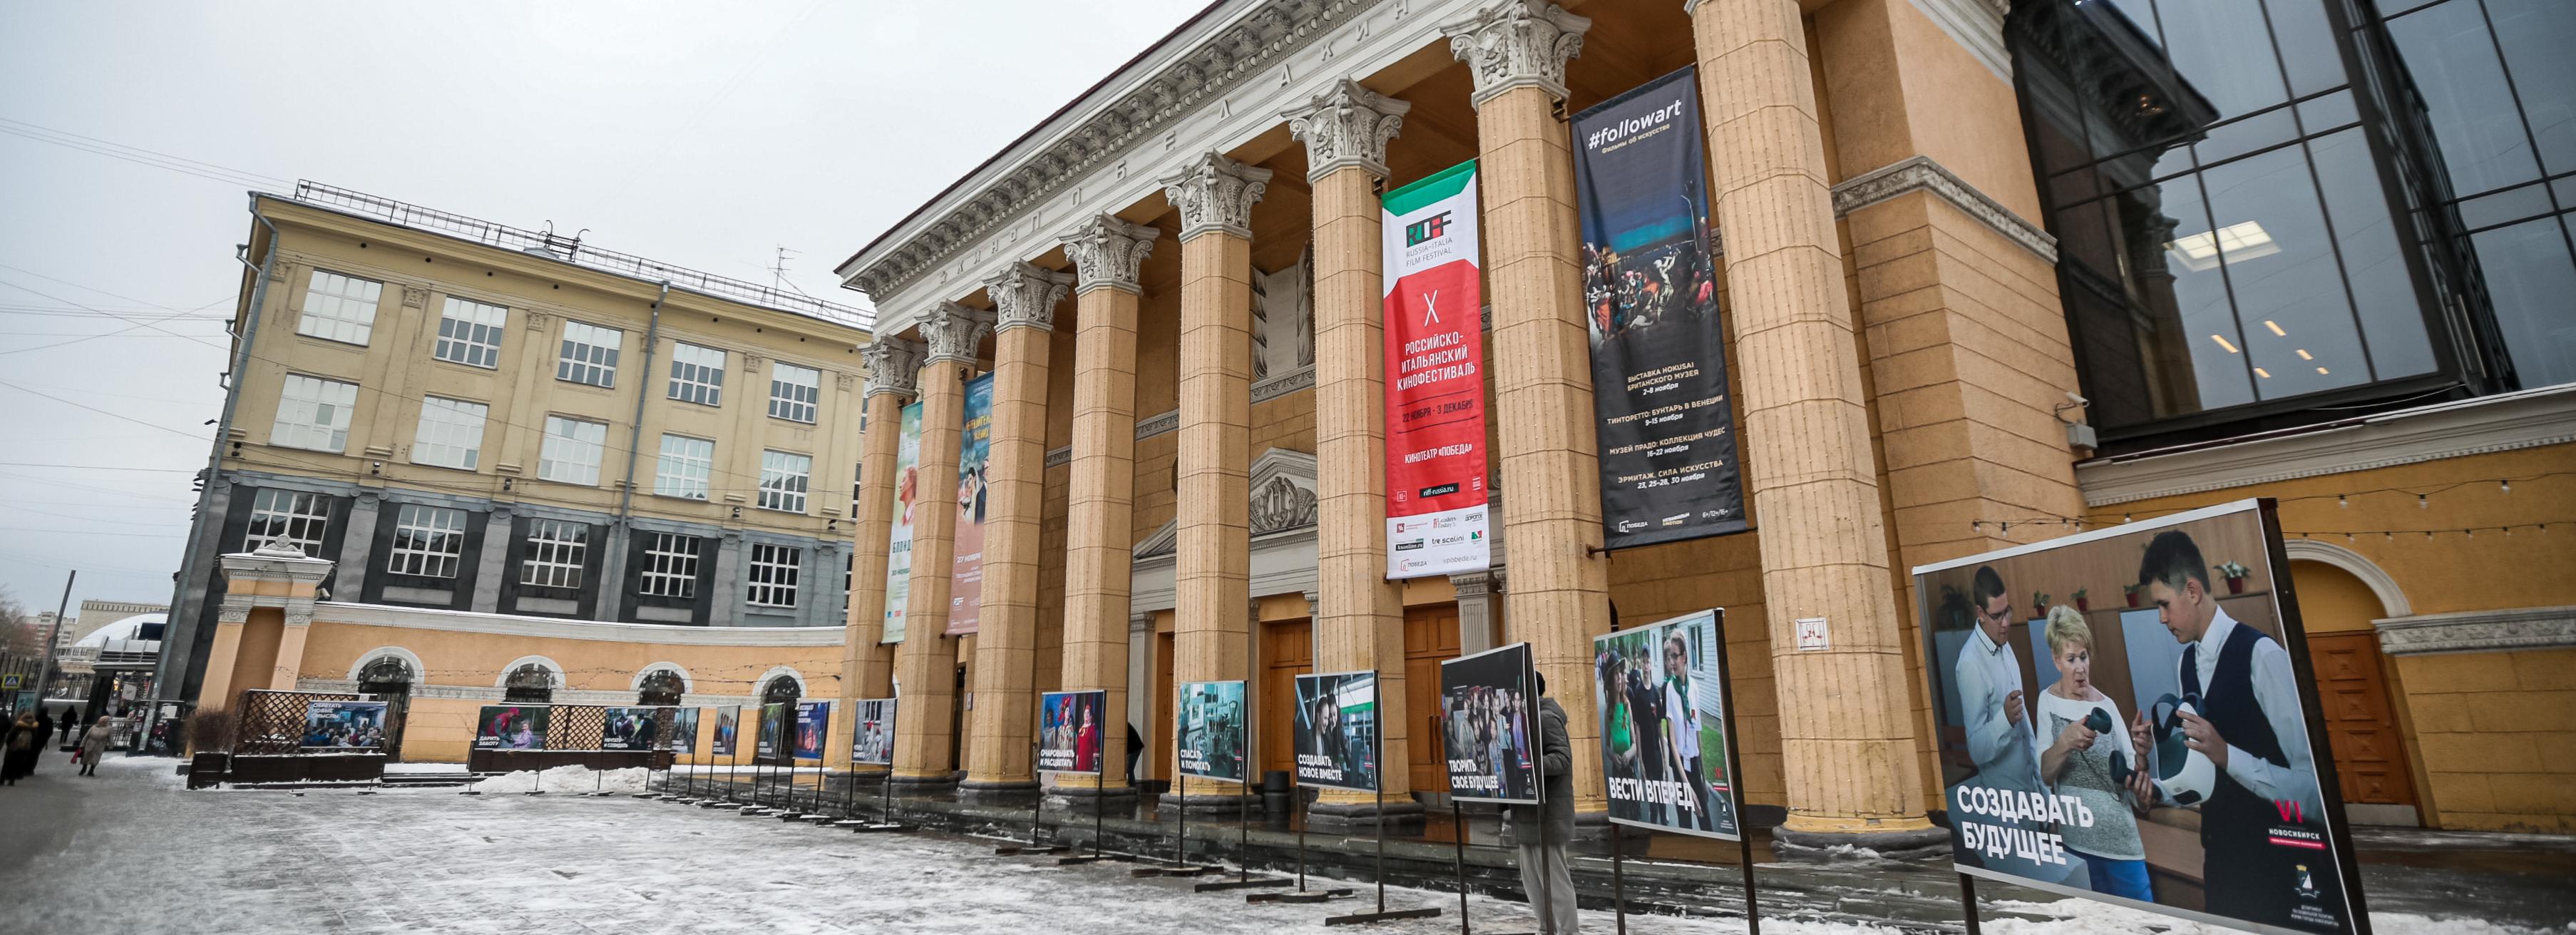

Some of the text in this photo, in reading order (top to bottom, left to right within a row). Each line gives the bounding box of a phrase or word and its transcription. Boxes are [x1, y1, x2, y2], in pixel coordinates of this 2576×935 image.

[1589, 99, 1682, 150] #followart
[1601, 140, 1627, 153] Фильмы
[1406, 237, 1453, 258] RUSSIA-ITALIA
[1406, 247, 1452, 267] FILM FESTIVAL
[1405, 332, 1464, 356] РОССИЙСКО-
[1401, 344, 1468, 374] ИТАЛЬЯНСКИЙ
[1397, 361, 1475, 392] КИНОФЕСТИВАЛЬ
[1627, 369, 1699, 391] БРИТАНСКОГО МУЗЕЯ
[1628, 362, 1694, 383] ВЫСТАВКА HOKUSAI
[1655, 382, 1679, 393] ноября
[1402, 413, 1410, 422] 22
[1410, 407, 1432, 421] НОЯБРЯ
[1437, 405, 1442, 414] 3
[1444, 399, 1473, 414] ДЕКАБРЯ
[1607, 412, 1651, 425] ТИНТОРЕТТО:
[1652, 404, 1683, 416] БУНТАРЬ
[1691, 394, 1723, 408] ВЕНЕЦИИ
[1659, 413, 1683, 423] ноября
[1610, 426, 1725, 455] МУЗЕЙ ПРАДО: КОЛЛЕКЦИЯ ЧУДЕС
[1405, 448, 1438, 464] КИНОТЕАТР
[1664, 444, 1689, 454] ноября
[1618, 459, 1723, 484] ЭРМИТАЖ. СИЛА ИСКУССТВА
[1680, 472, 1705, 482] ноября
[1423, 486, 1454, 496] riff-russia.ru
[1443, 555, 1477, 564] vpobede.ru
[1041, 749, 1075, 758] ОЧАРОВЫВАТЬ
[1180, 749, 1203, 760] СПАСАТЬ
[1298, 754, 1332, 767] СОЗДАВАТЬ
[1044, 758, 1073, 767] РАСЦВЕТАТЬ
[1181, 760, 1211, 772] И ПОМОГАТЬ
[1449, 759, 1477, 772] ТВОРИТЬ
[1299, 767, 1343, 781] НОВОЕ ВМЕСТЕ
[1452, 775, 1499, 791] СВОЕ БУДУЩЕЕ
[1608, 777, 1695, 812] ВЕСТИ ВПЕРЕД
[1957, 785, 2094, 827] СОЗДАВАТЬ
[2275, 799, 2303, 823] VI
[2269, 828, 2320, 839] НОВОСИБИРСК
[1961, 821, 2066, 866] БУДУЩЕЕ
